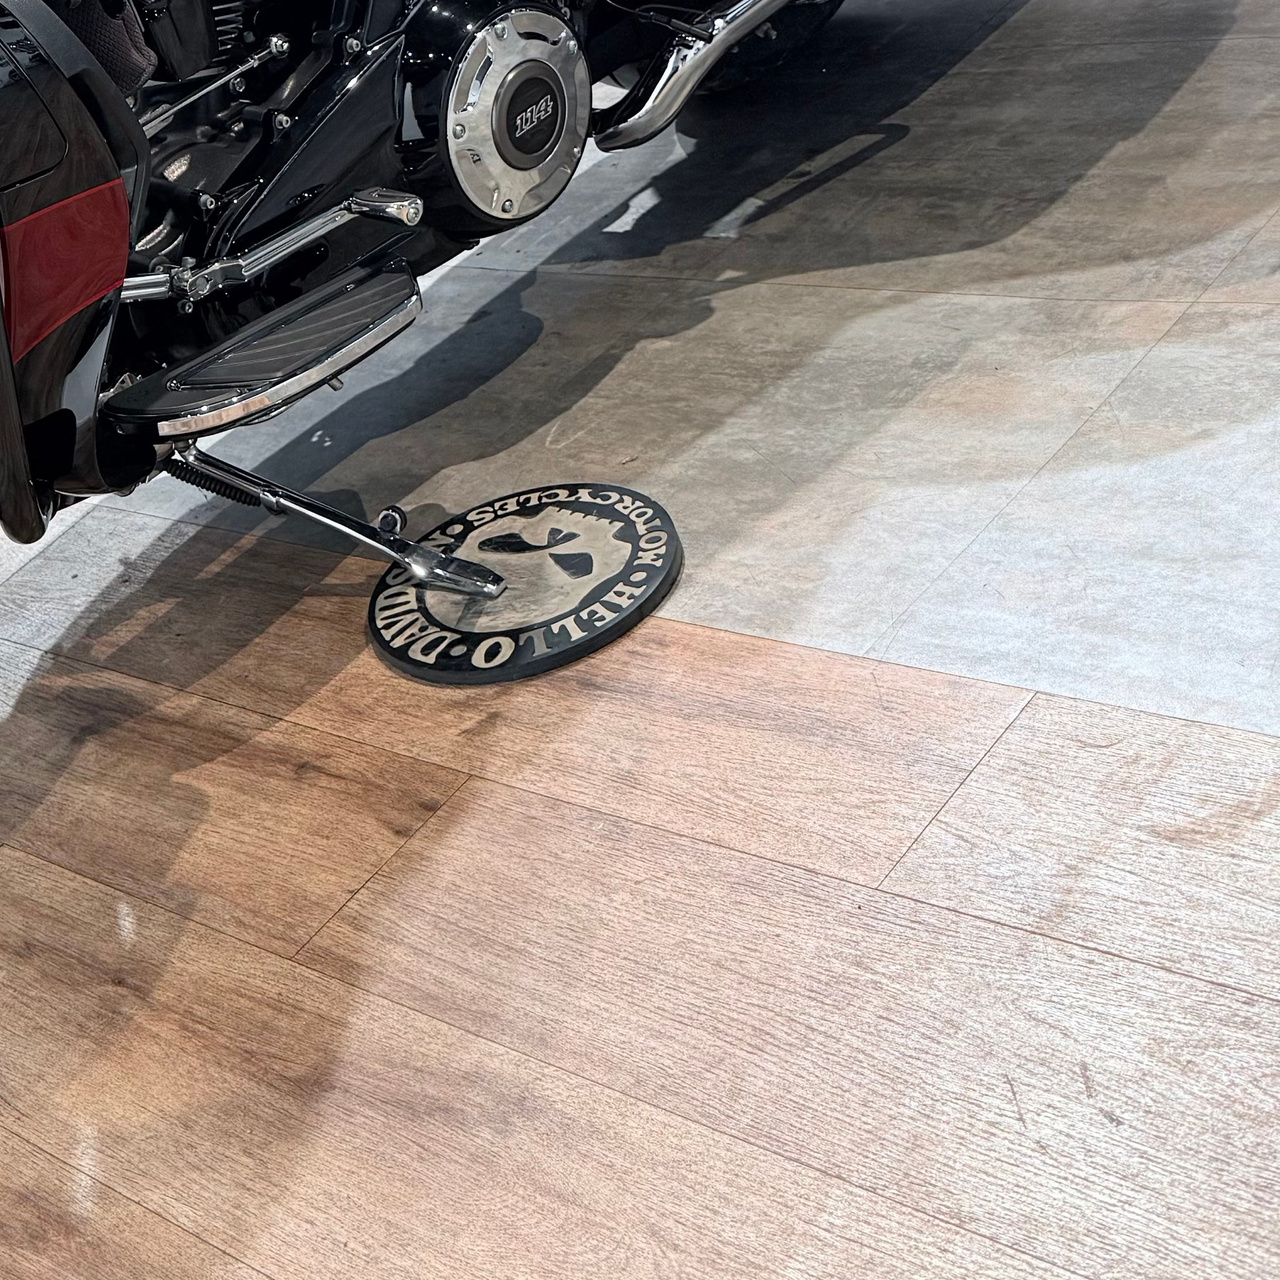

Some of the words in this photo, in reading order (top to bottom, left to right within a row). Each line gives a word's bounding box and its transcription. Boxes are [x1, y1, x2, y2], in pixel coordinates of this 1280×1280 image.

[515, 94, 554, 138] 114
[466, 488, 669, 567] MOTORCYCLES
[375, 529, 462, 665] DAVIDSN
[471, 582, 647, 669] HELLO
